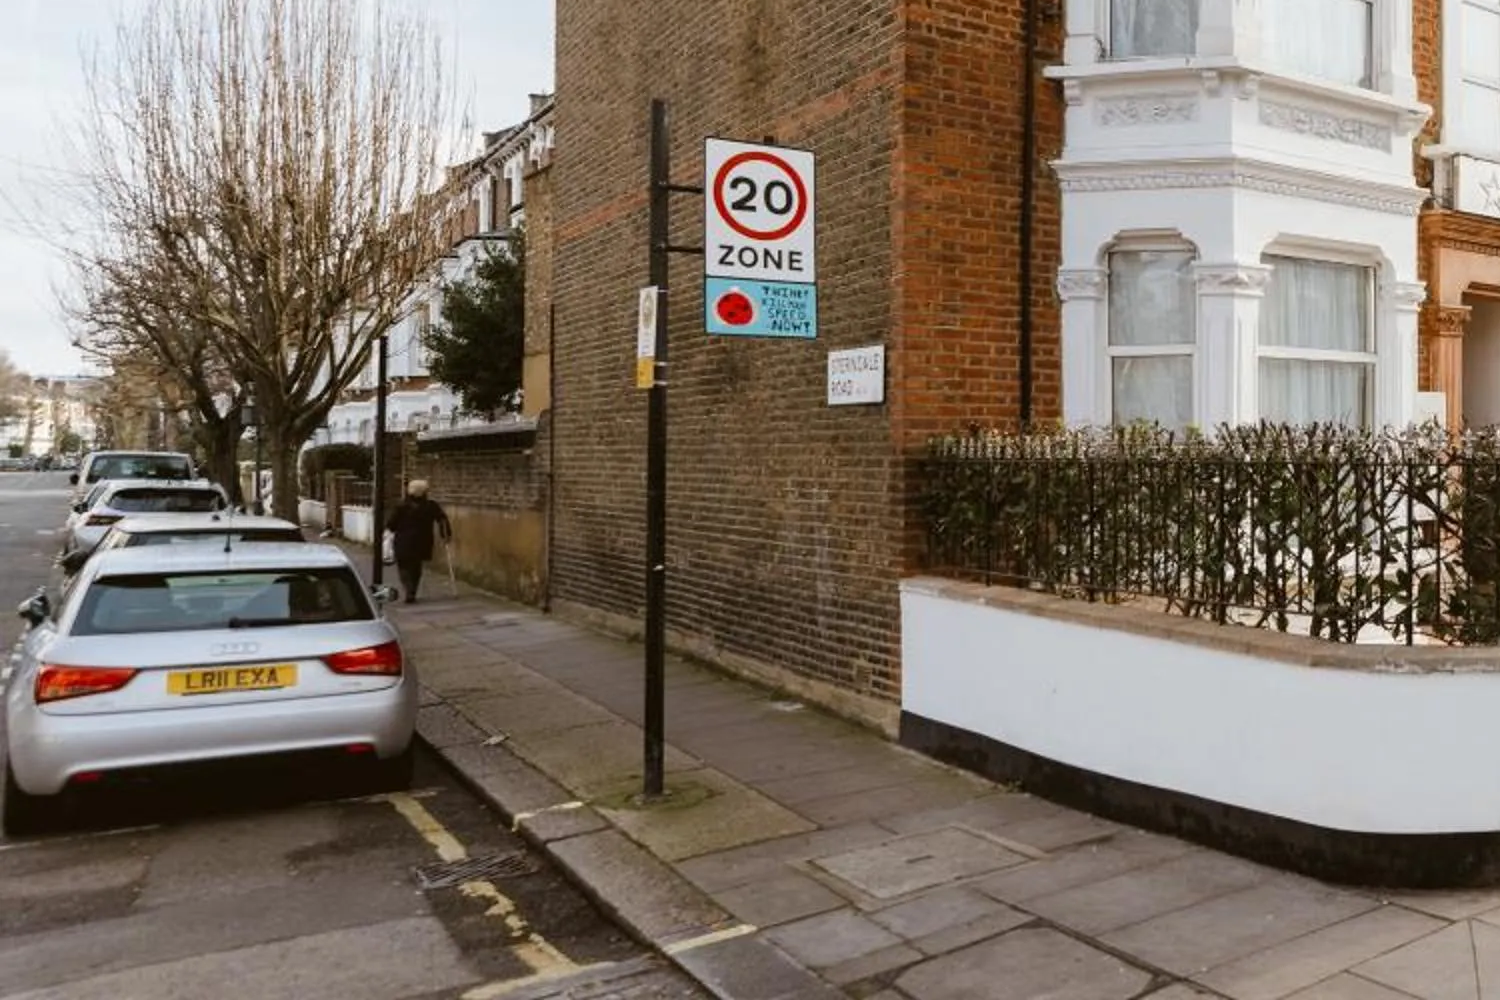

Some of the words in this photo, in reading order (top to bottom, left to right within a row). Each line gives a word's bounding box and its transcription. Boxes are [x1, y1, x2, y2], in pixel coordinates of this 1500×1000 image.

[728, 176, 793, 215] 20
[718, 244, 804, 271] ZONE
[185, 670, 229, 689] LR11
[236, 667, 279, 685] EXA
